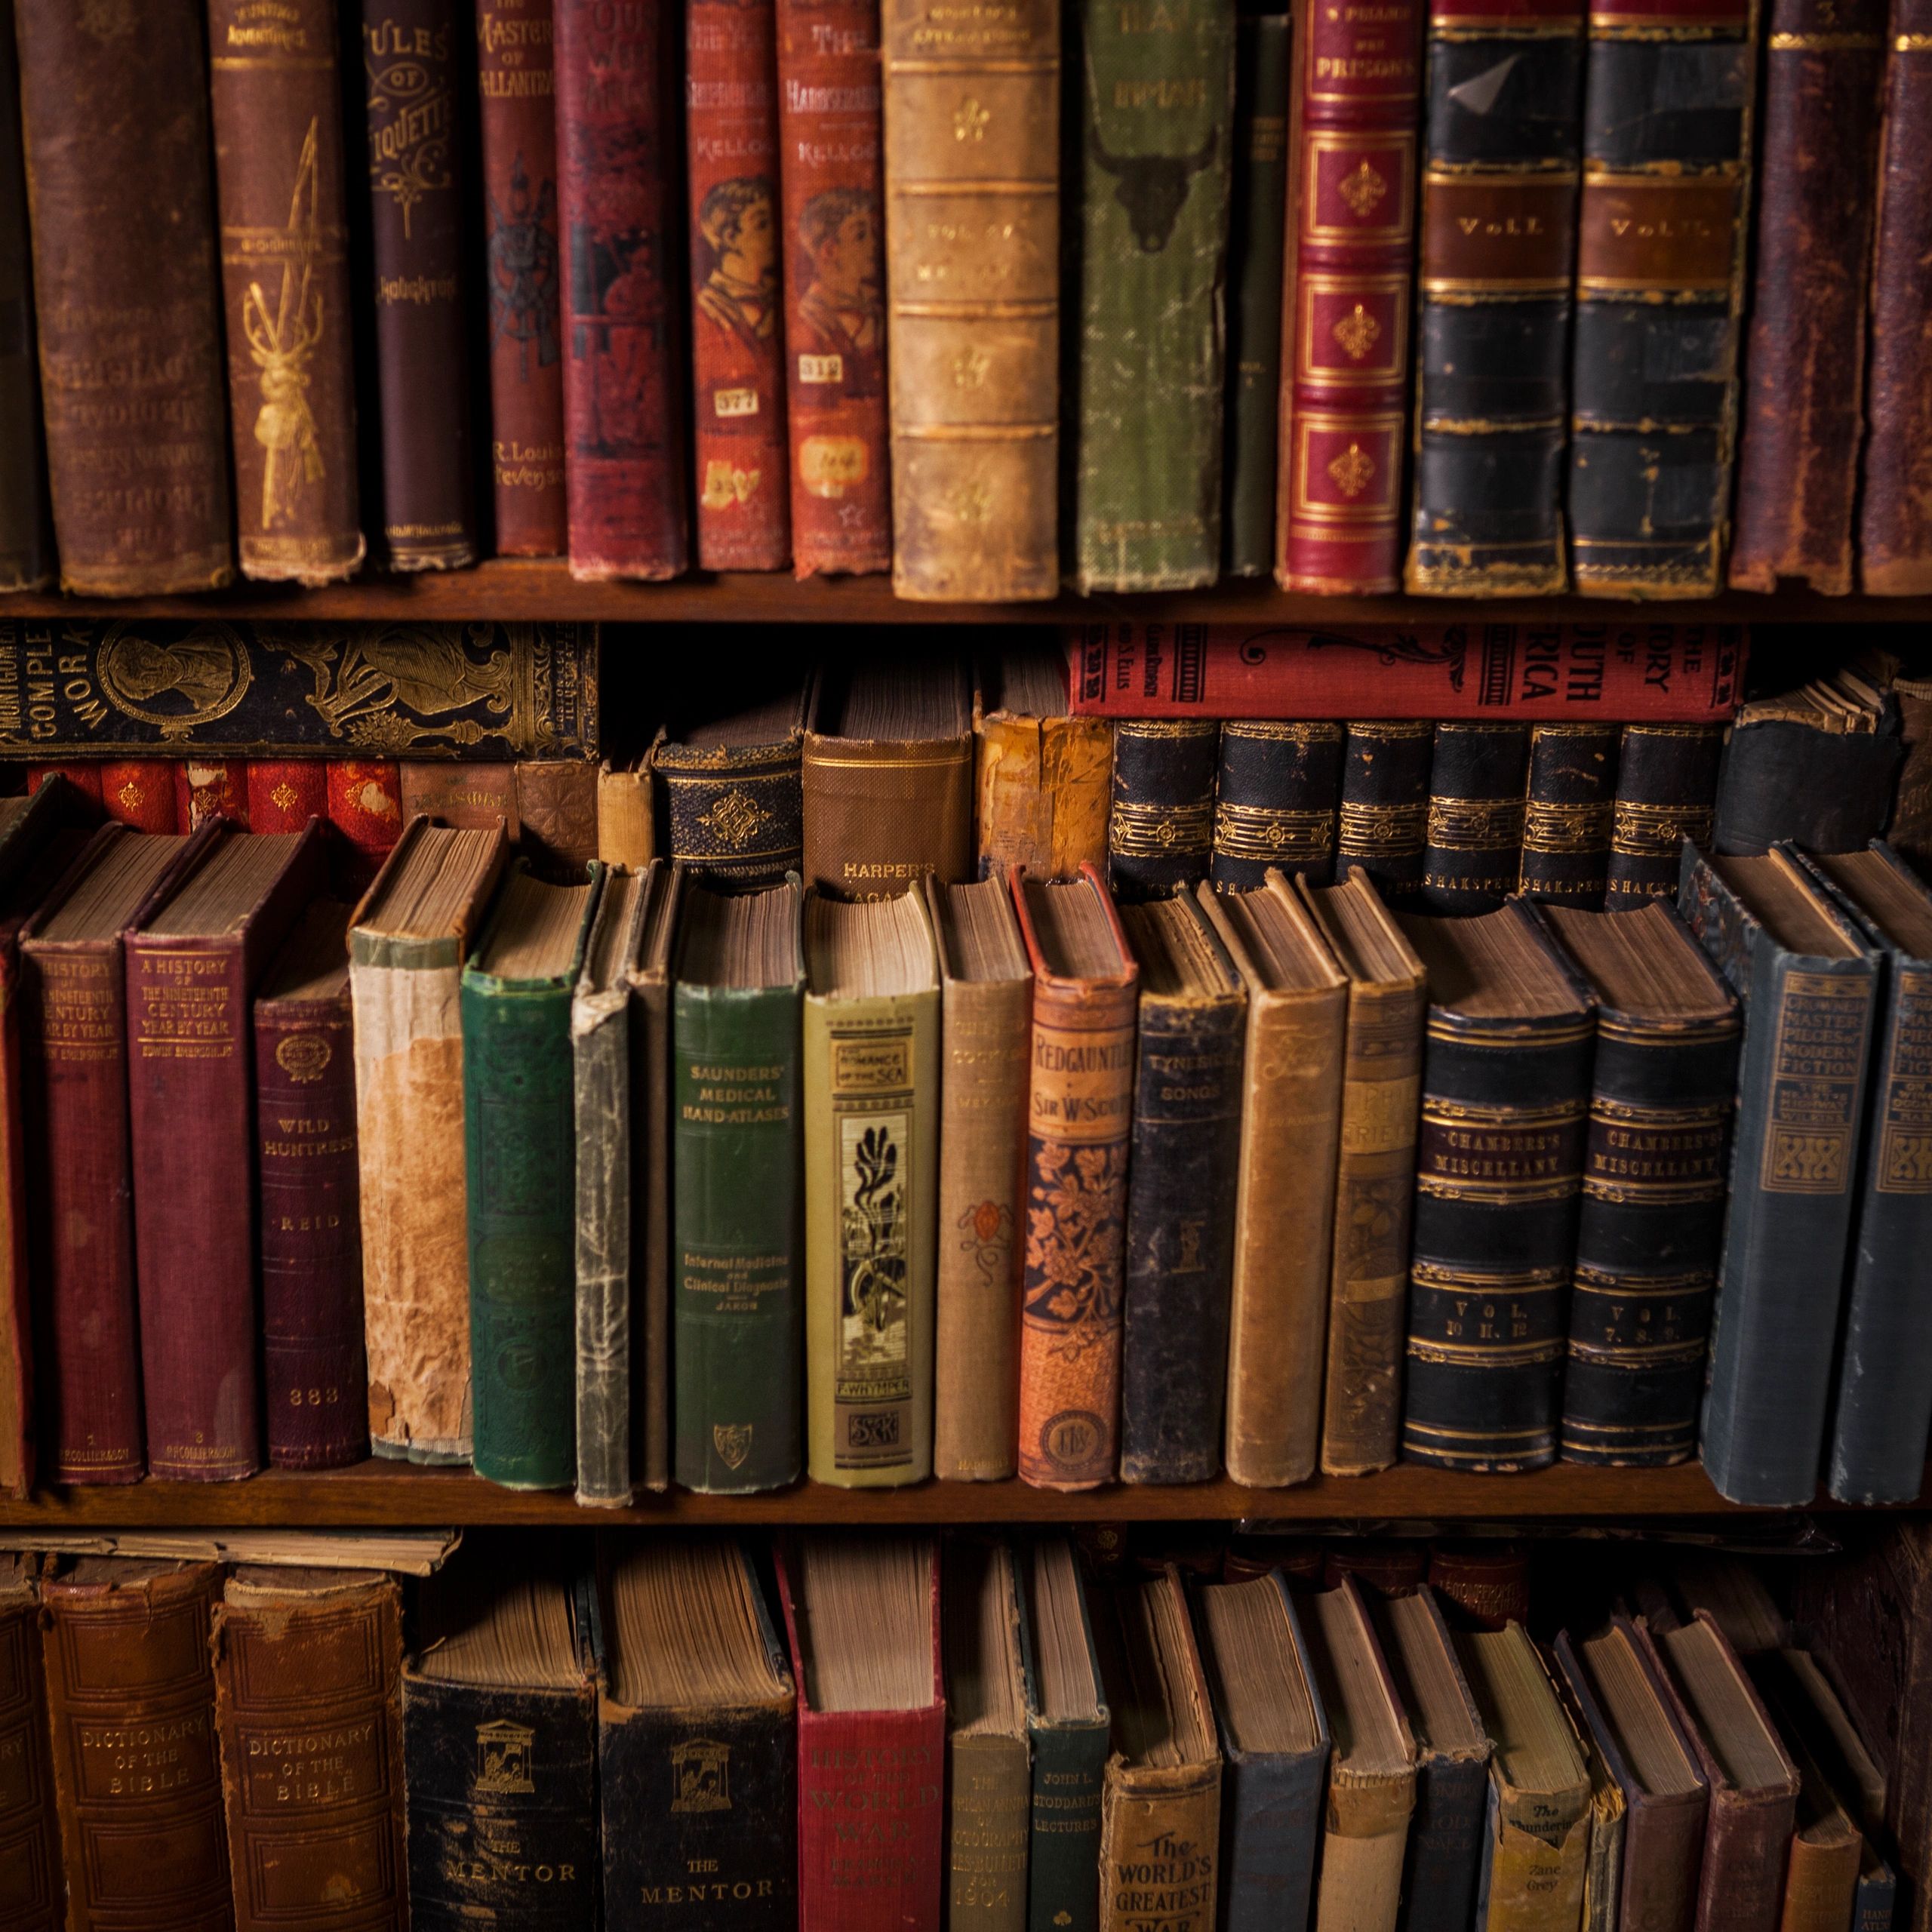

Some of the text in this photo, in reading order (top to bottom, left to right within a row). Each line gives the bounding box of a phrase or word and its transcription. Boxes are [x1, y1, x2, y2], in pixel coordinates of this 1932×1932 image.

[365, 19, 449, 59] ULES
[390, 69, 417, 86] OF
[373, 88, 451, 163] IQUETTE
[1617, 633, 1636, 665] OF
[0, 626, 21, 728] MONTGOMER
[26, 628, 57, 739] COMPLE
[58, 621, 108, 730] WORK
[1117, 659, 1133, 689] ELLIS
[157, 959, 226, 974] HISTORY
[45, 1005, 109, 1022] ENTURY
[148, 1003, 226, 1018] CENTURY
[63, 1023, 77, 1037] BY
[81, 1023, 115, 1038] YEAR
[142, 1020, 229, 1035] YEAR BY YEAR
[691, 1065, 785, 1082] SAUNDERS'
[1780, 1059, 1856, 1076] FICTION
[699, 1087, 775, 1103] MEDICAL
[278, 1119, 329, 1134] WILD
[1435, 1155, 1558, 1177] MISCELLANY
[1594, 1153, 1718, 1177] MISCELLANY
[281, 1216, 340, 1231] REID
[82, 1715, 206, 1748] DICTIONARY
[249, 1724, 372, 1756] DICTIONARY
[115, 1749, 178, 1769] OF THE
[282, 1756, 344, 1777] OF THE
[811, 1743, 934, 1769] HISTORY
[109, 1768, 189, 1794] BIBLE
[277, 1777, 355, 1801] BIBLE
[1044, 1774, 1075, 1786] JOHN
[809, 1785, 940, 1811] WORLD
[833, 1821, 915, 1844] WAR
[1035, 1820, 1097, 1832] LECTURES
[1510, 1817, 1573, 1835] Thunderin
[491, 1839, 520, 1854] THE
[1137, 1832, 1198, 1858] The
[446, 1860, 576, 1883] MENTOR
[688, 1859, 718, 1873] THE
[1118, 1857, 1211, 1884] WORLD'S
[641, 1879, 773, 1903] MENTOR
[1116, 1883, 1211, 1912] GREATEST
